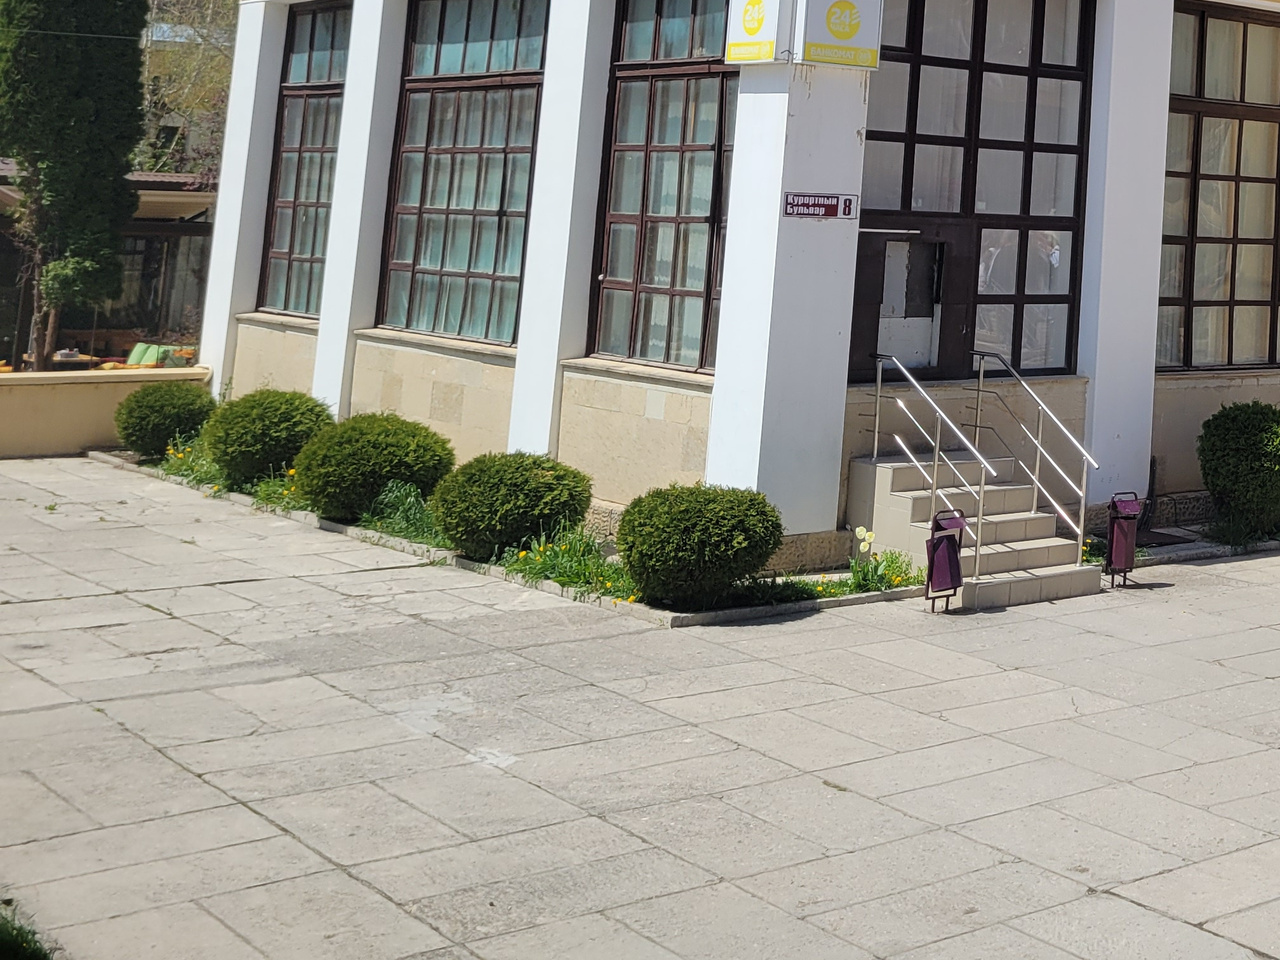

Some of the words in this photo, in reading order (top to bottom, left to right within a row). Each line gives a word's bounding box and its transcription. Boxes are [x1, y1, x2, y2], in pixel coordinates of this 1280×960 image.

[745, 4, 759, 20] 24
[830, 8, 850, 25] 24
[810, 46, 856, 60] БАНКОМАТ
[786, 204, 826, 216] Бульвар
[842, 198, 853, 216] 8
